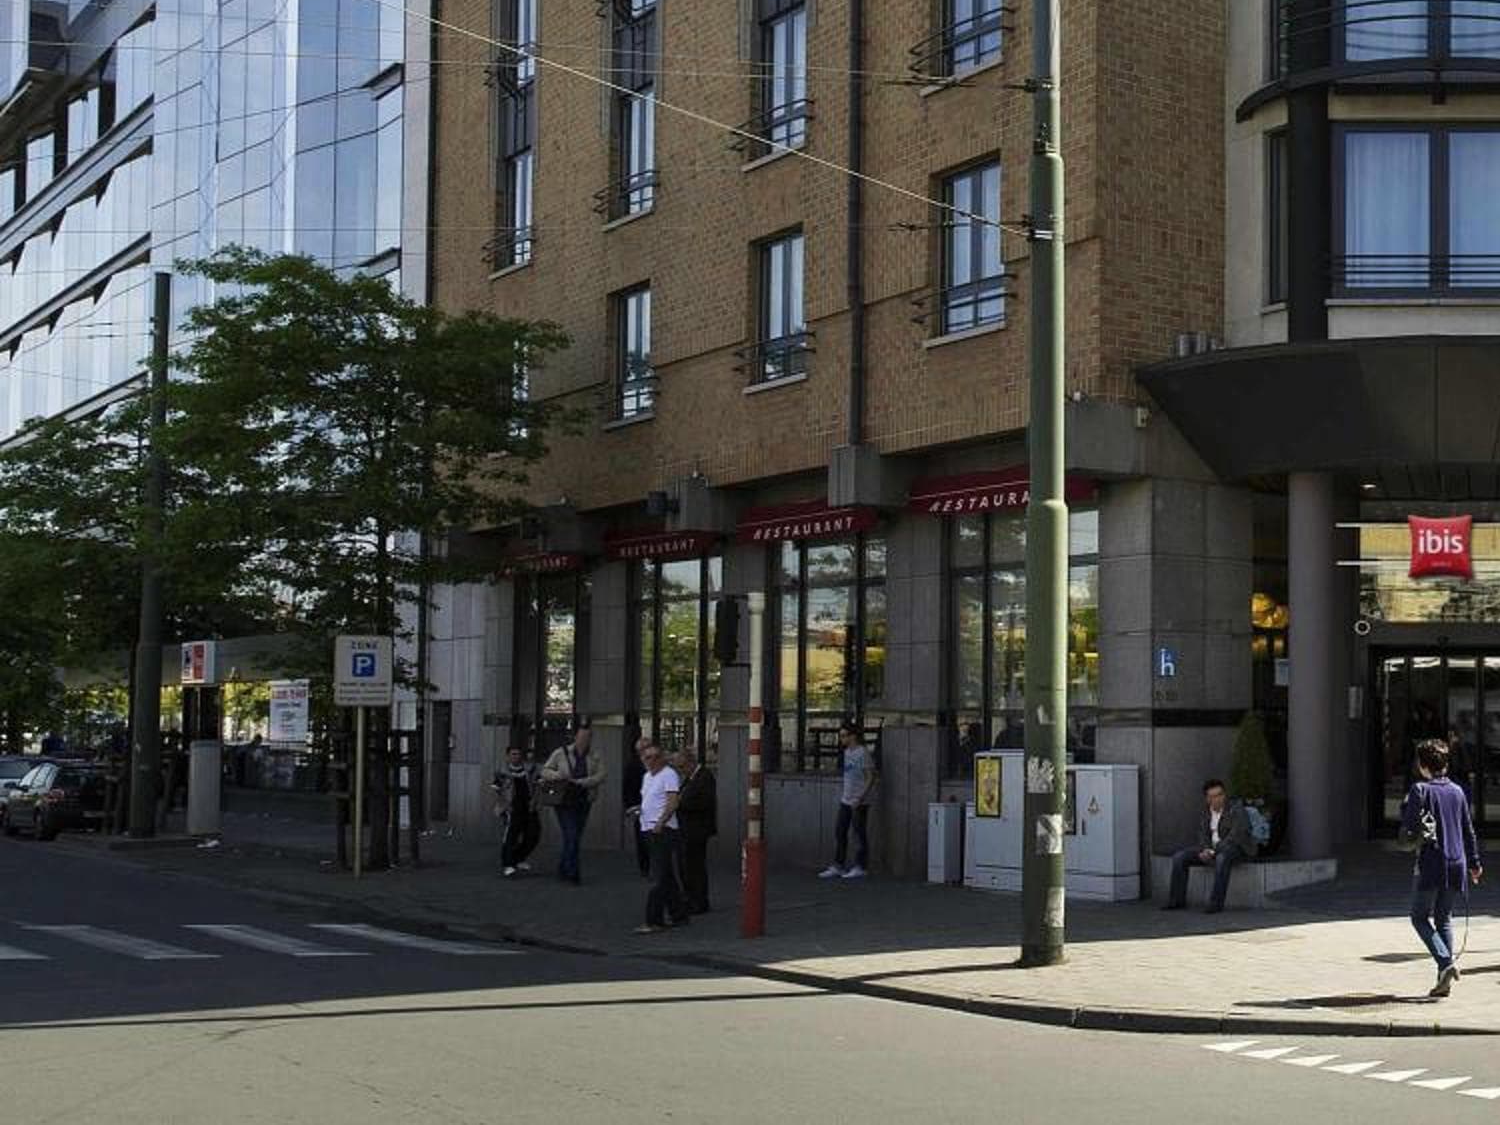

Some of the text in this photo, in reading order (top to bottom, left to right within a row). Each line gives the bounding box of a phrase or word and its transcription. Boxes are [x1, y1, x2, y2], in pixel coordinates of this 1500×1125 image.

[929, 490, 1031, 513] RESTAURA
[753, 516, 853, 540] RESTAURANT
[1418, 528, 1465, 555] ibis
